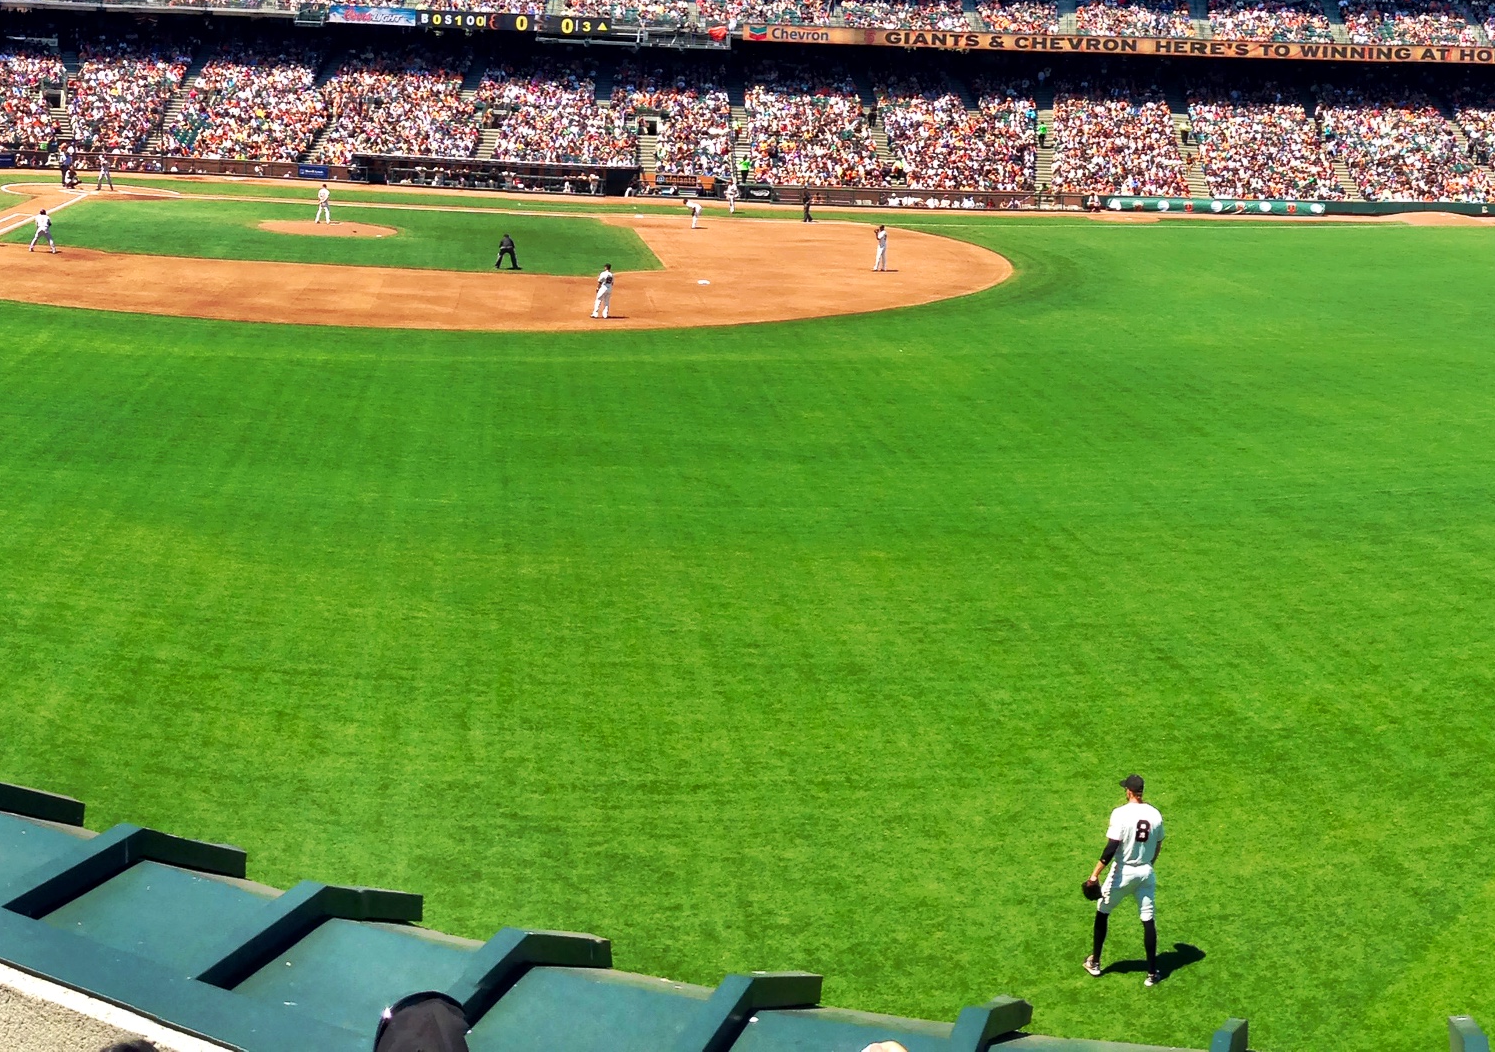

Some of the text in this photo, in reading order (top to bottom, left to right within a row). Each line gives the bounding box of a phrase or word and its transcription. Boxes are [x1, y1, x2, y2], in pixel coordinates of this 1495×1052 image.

[771, 27, 1137, 52] Chevron GIANTS & CHEVRON
[1156, 40, 1249, 56] HERE'S
[1262, 44, 1290, 57] TO
[1300, 45, 1411, 60] WINNING
[1420, 48, 1449, 60] AT
[1135, 819, 1151, 843] 8
